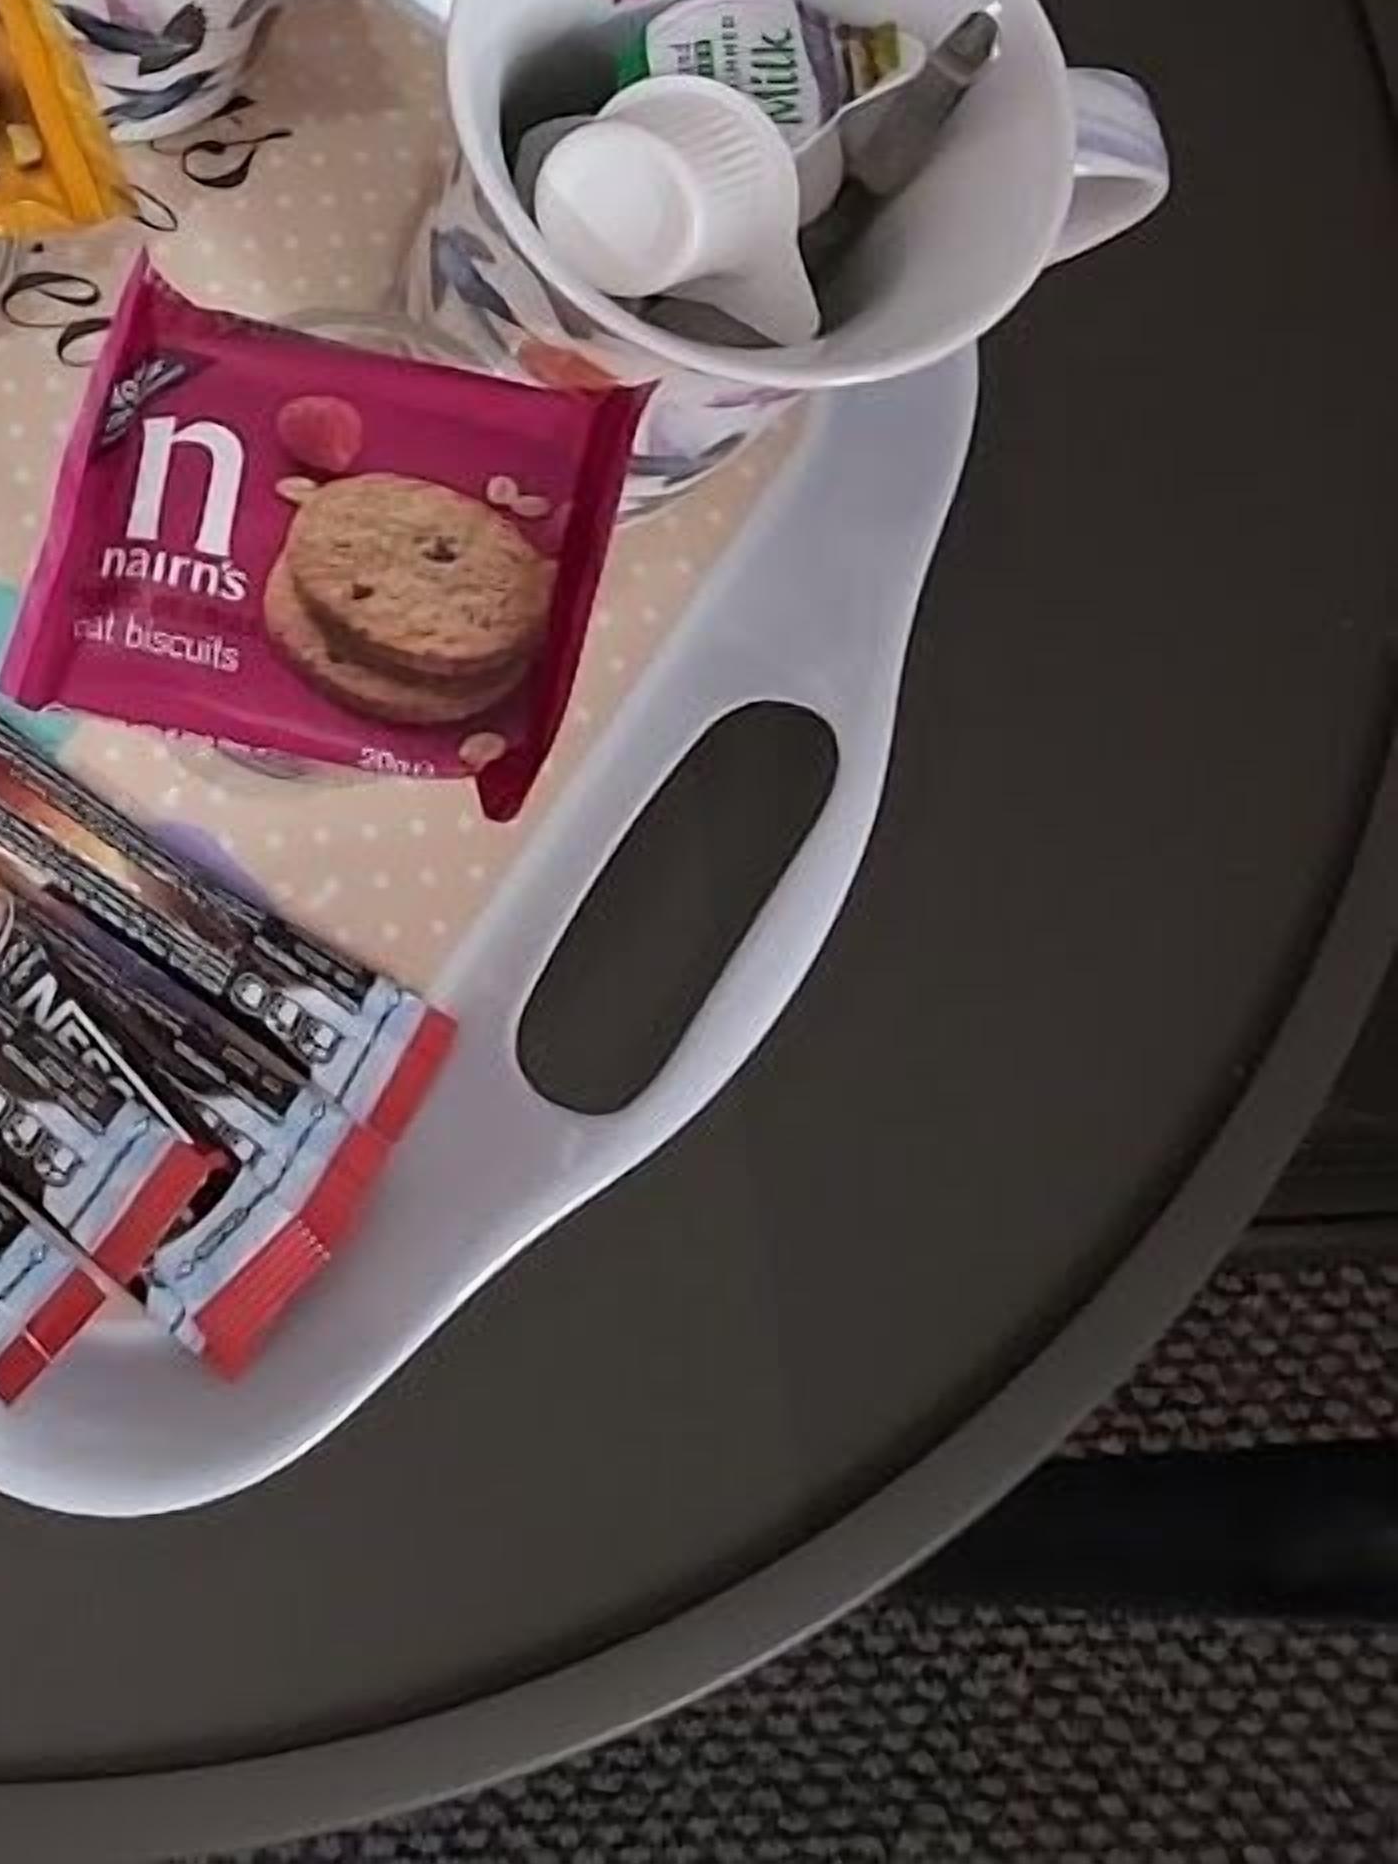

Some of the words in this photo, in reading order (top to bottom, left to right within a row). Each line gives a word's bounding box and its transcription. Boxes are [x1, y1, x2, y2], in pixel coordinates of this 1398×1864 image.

[749, 28, 804, 125] Milk
[101, 547, 249, 601] nairn's
[125, 613, 240, 673] biscuits
